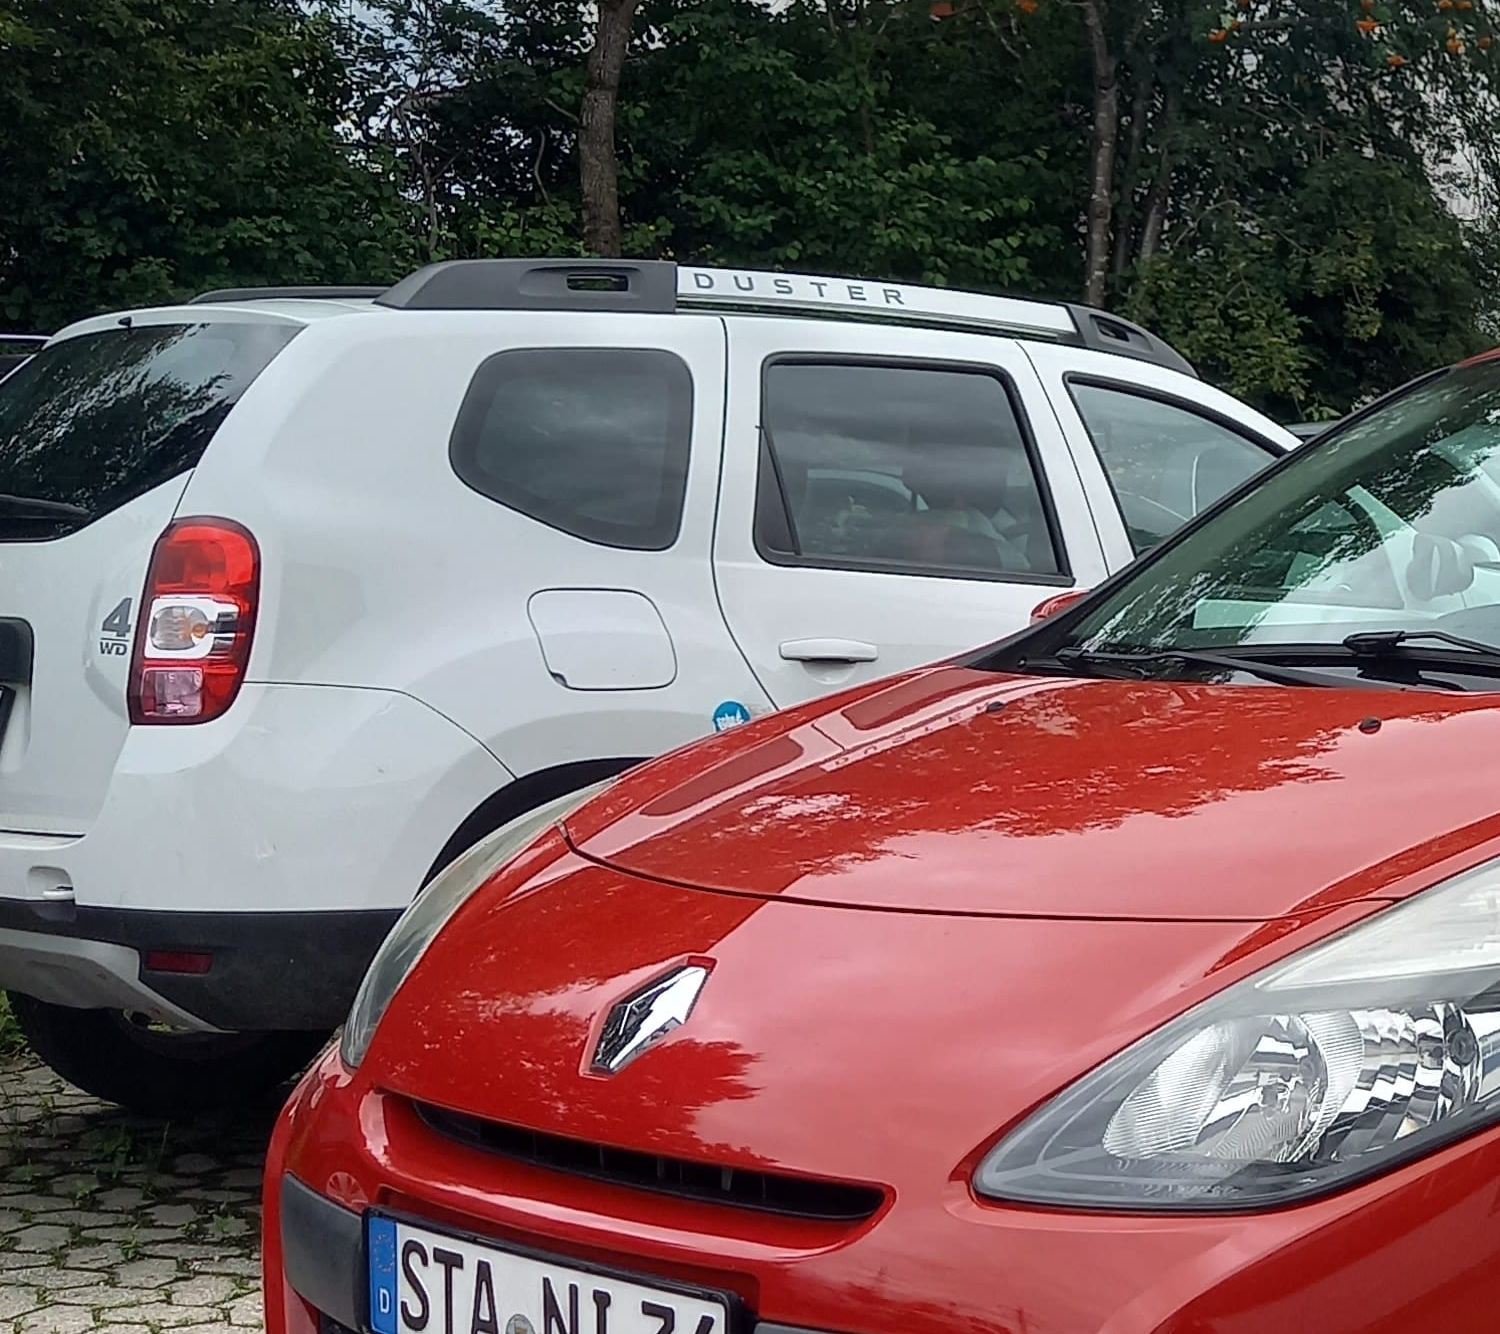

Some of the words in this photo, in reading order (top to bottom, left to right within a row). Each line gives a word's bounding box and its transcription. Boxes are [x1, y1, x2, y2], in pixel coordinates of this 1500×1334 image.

[693, 272, 905, 305] DUSTER
[101, 597, 133, 637] 4
[99, 641, 128, 656] WD
[378, 1287, 391, 1314] D
